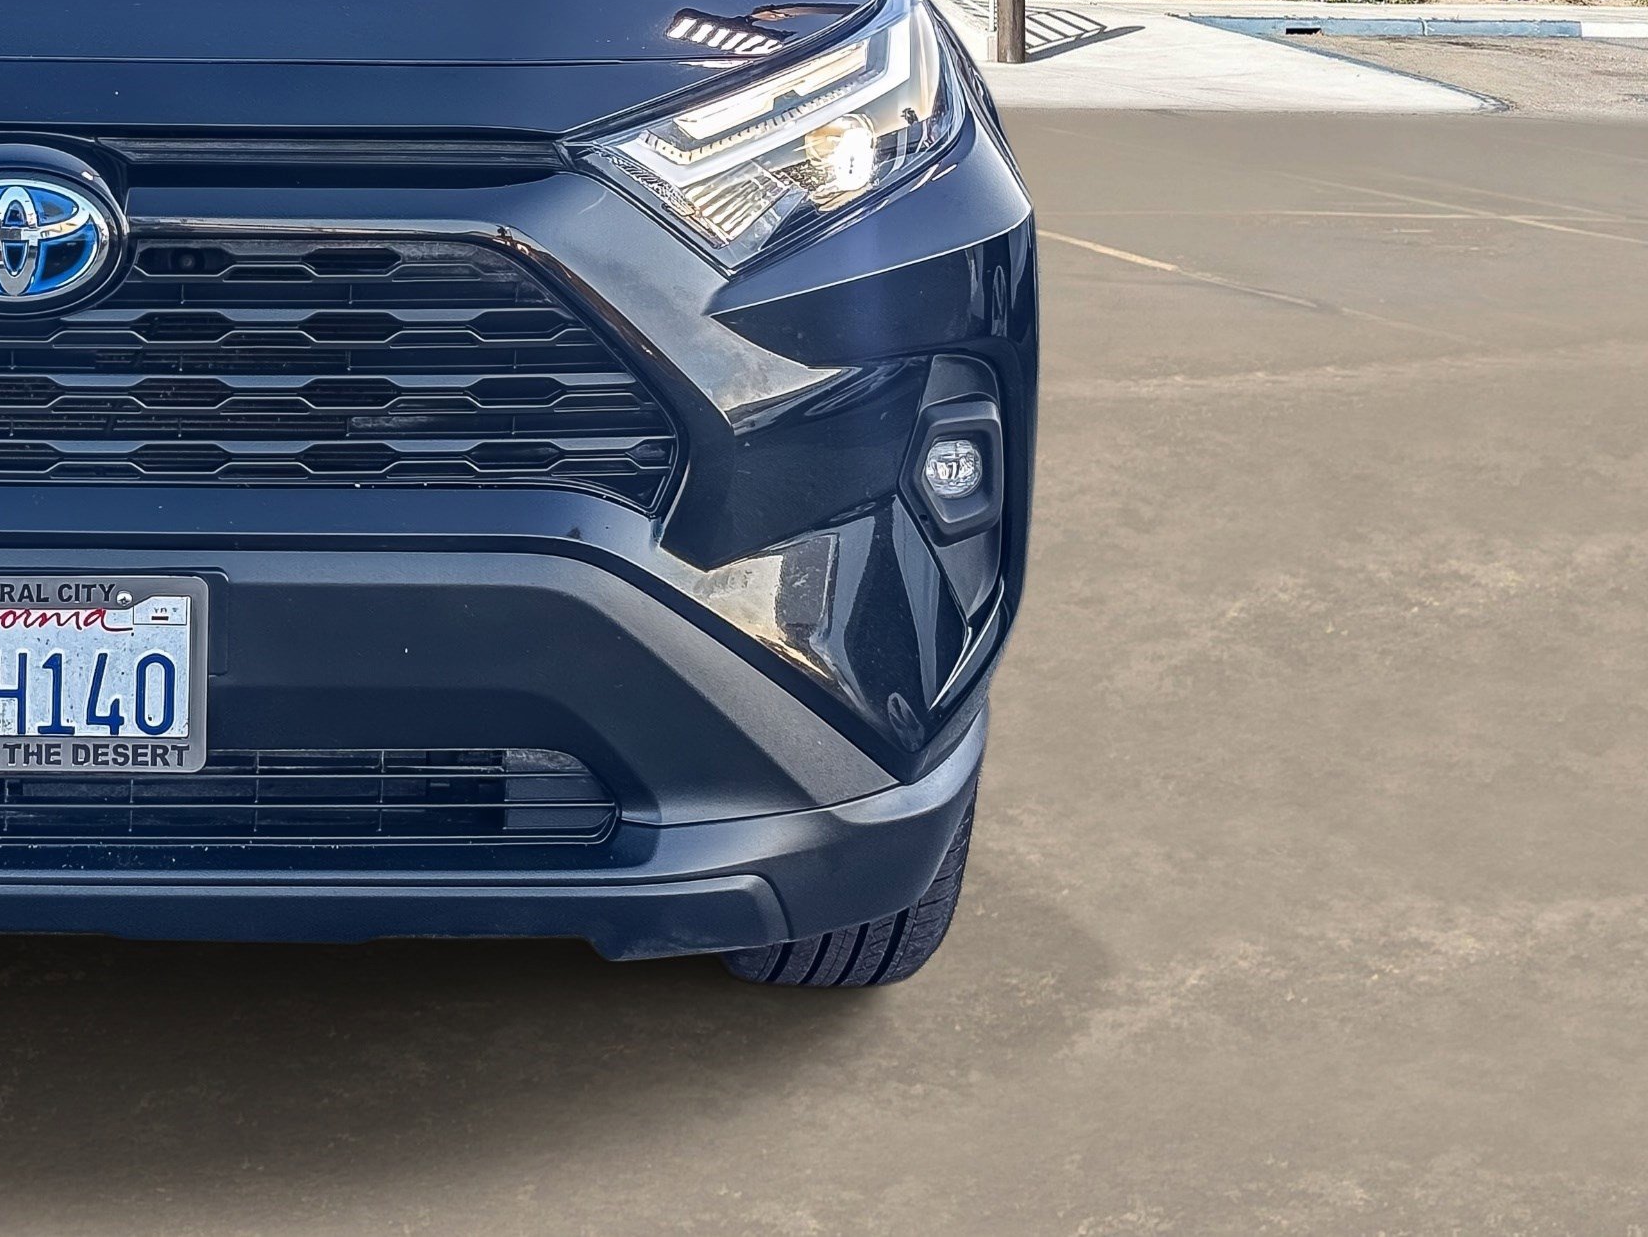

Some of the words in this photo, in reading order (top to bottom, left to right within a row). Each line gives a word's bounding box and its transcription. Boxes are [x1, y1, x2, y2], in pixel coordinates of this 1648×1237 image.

[58, 583, 116, 603] CITY
[3, 744, 62, 766] THE
[72, 744, 190, 767] DESERT
